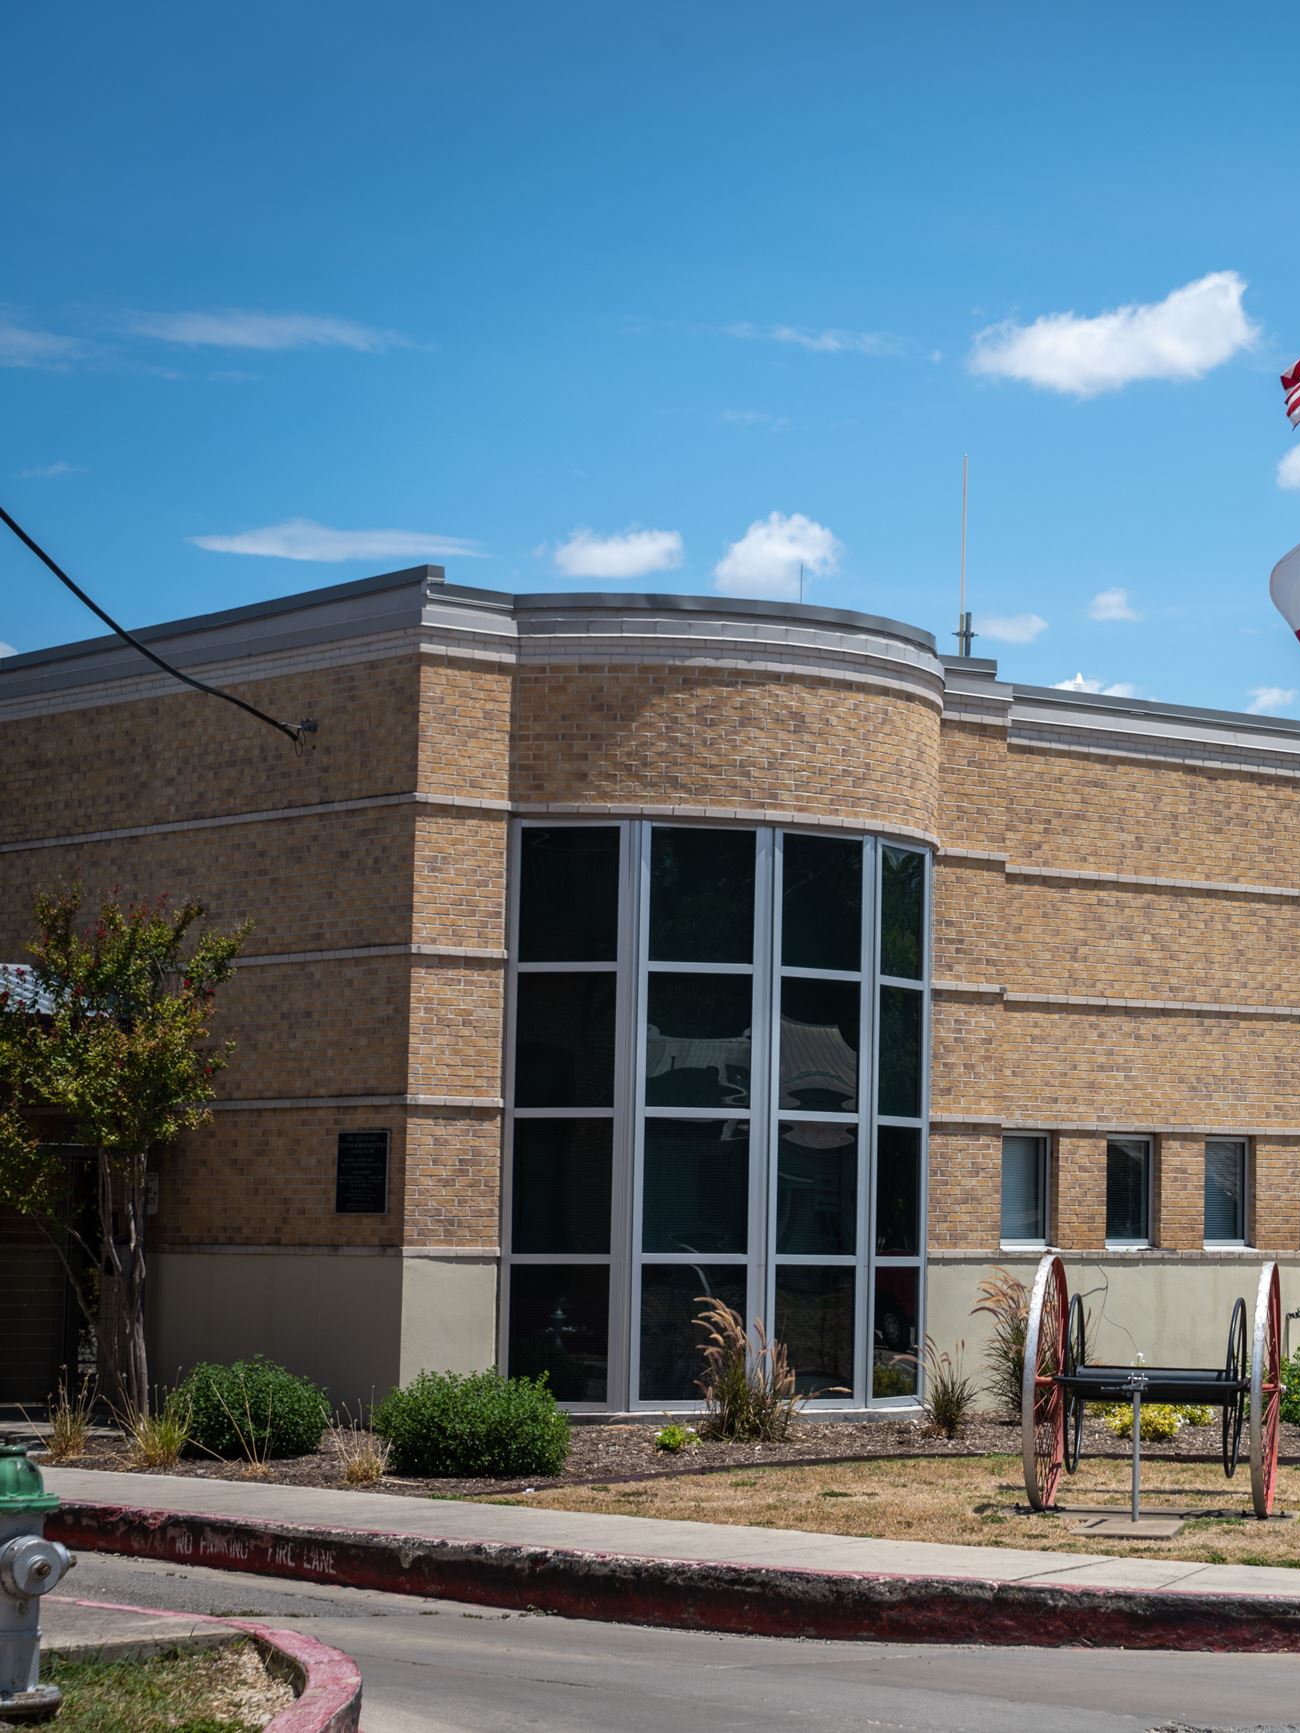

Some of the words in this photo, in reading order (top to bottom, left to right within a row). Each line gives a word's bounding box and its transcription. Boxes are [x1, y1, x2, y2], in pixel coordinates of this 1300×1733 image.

[176, 1533, 193, 1555] NO
[267, 1543, 296, 1567] FIRE
[303, 1546, 337, 1575] LANE
